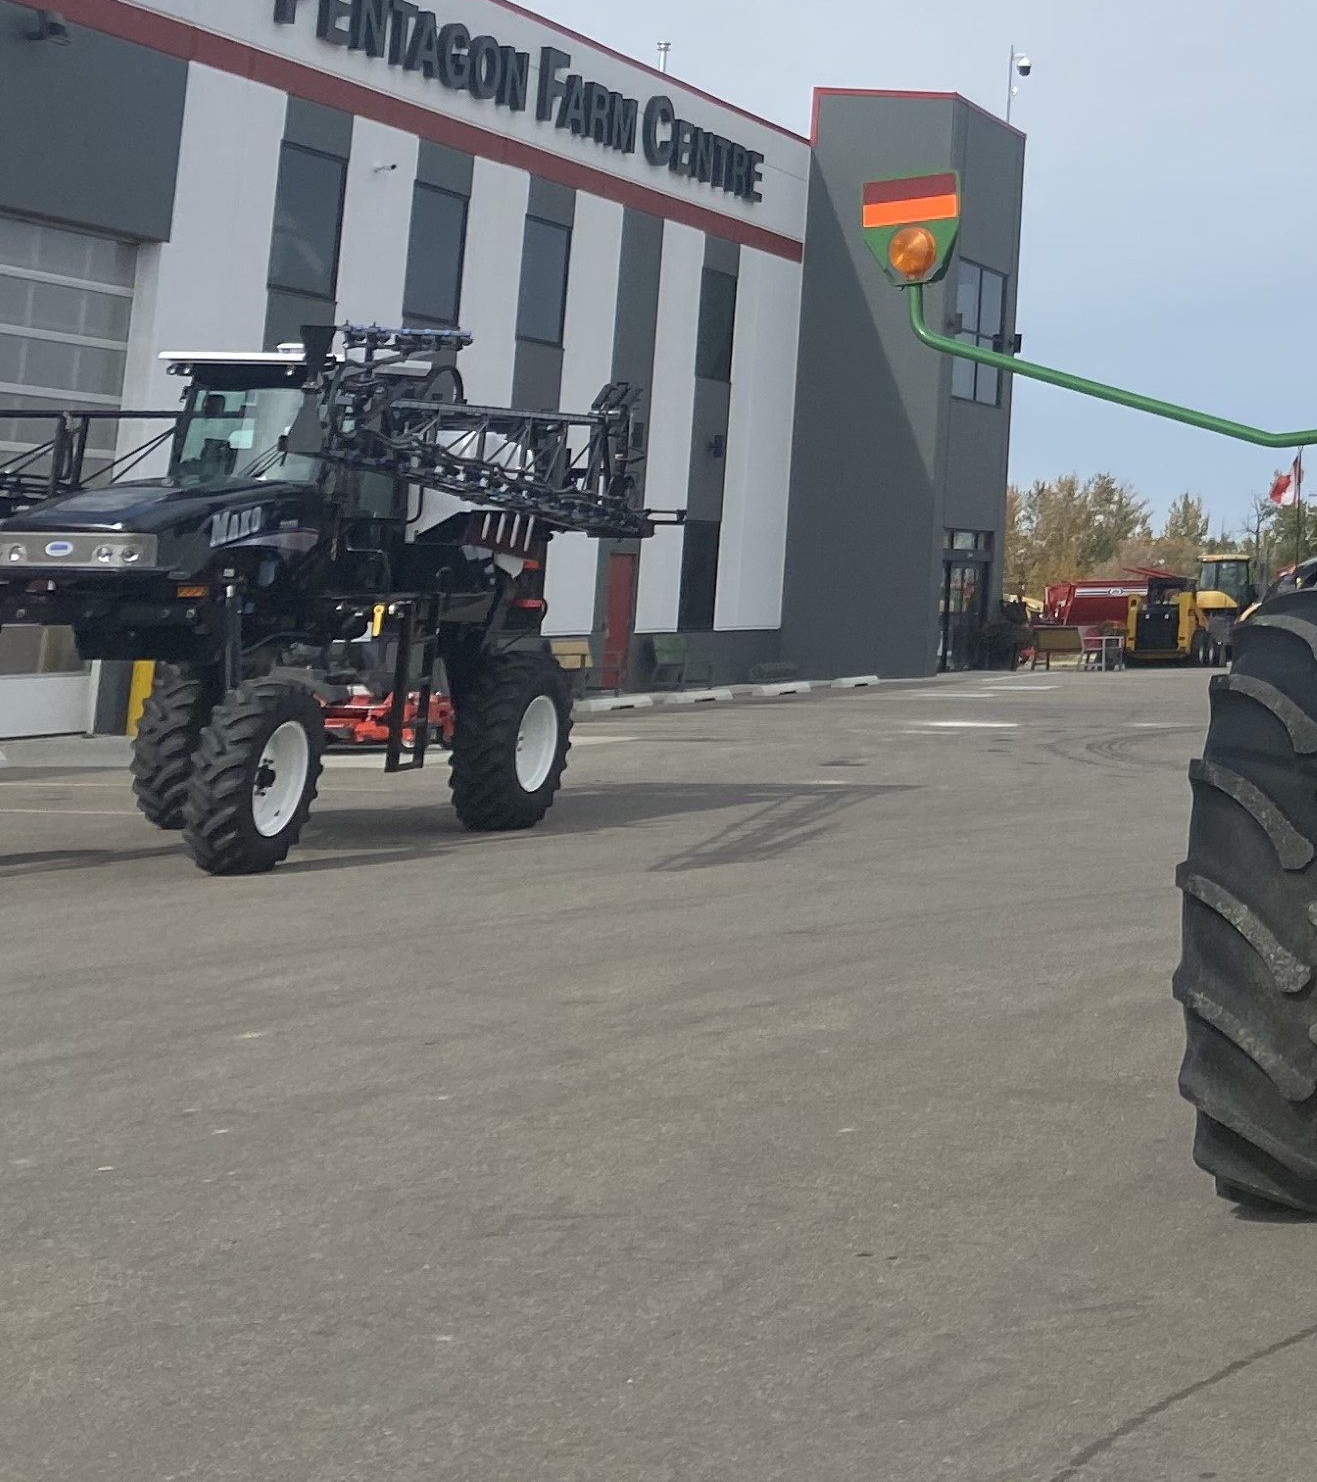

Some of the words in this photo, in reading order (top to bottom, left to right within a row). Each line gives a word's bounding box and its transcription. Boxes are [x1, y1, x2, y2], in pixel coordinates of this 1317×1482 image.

[536, 46, 638, 154] FARM
[643, 95, 765, 203] CENTRE
[209, 506, 262, 548] MAKO
